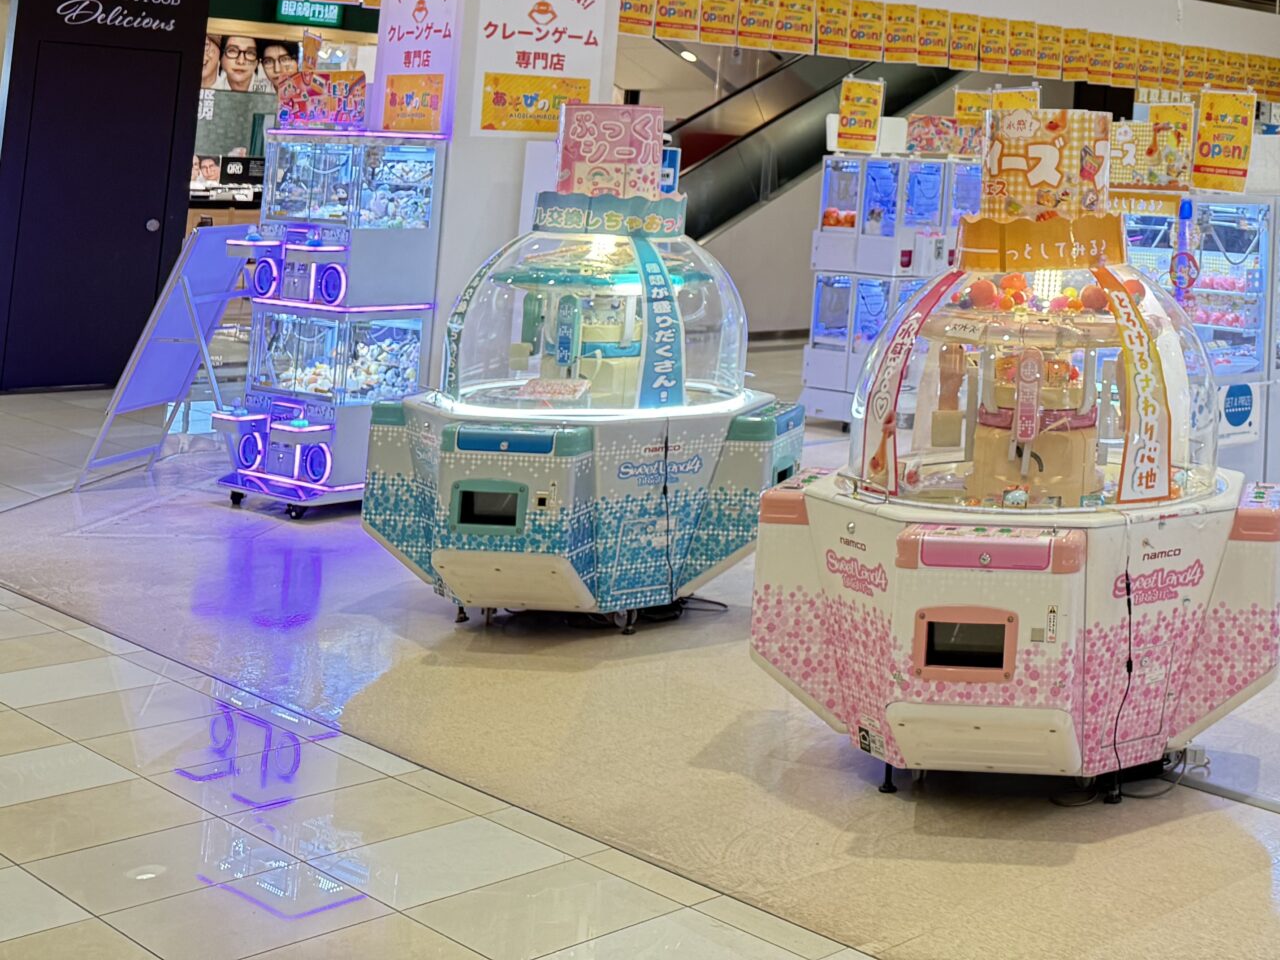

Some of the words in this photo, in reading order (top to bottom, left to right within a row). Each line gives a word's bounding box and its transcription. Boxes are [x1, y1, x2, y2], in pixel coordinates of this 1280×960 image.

[387, 22, 452, 43] クレーンゲーム
[483, 21, 599, 47] クレーンゲーム
[403, 50, 431, 68] 専門店
[515, 50, 566, 71] 専門店
[840, 536, 866, 551] namco
[1142, 548, 1181, 561] namco
